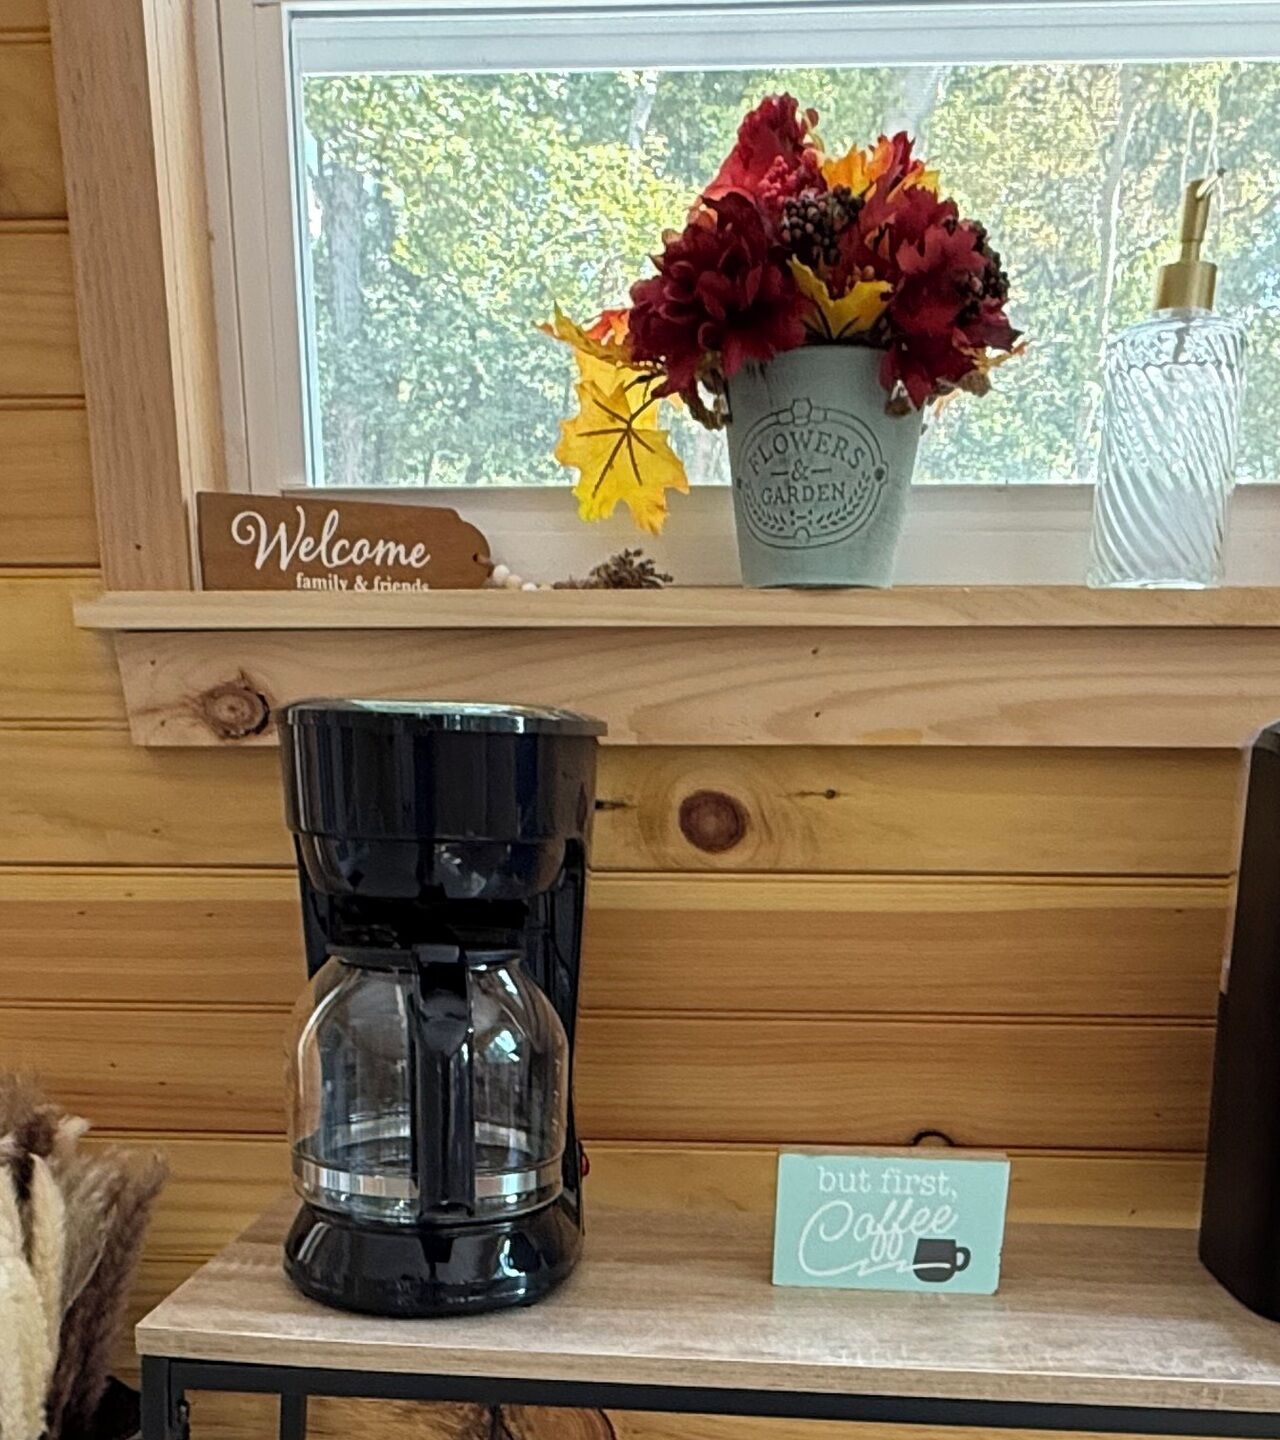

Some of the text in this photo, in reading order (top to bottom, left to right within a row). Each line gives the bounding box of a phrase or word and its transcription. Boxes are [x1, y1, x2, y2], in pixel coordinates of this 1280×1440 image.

[748, 429, 866, 477] FLOWERS
[791, 459, 810, 482] &
[761, 482, 846, 506] GARDEN
[231, 505, 431, 572] Welcome
[296, 572, 429, 592] family & friends
[817, 1165, 958, 1199] but first,
[798, 1197, 959, 1277] Coffee
